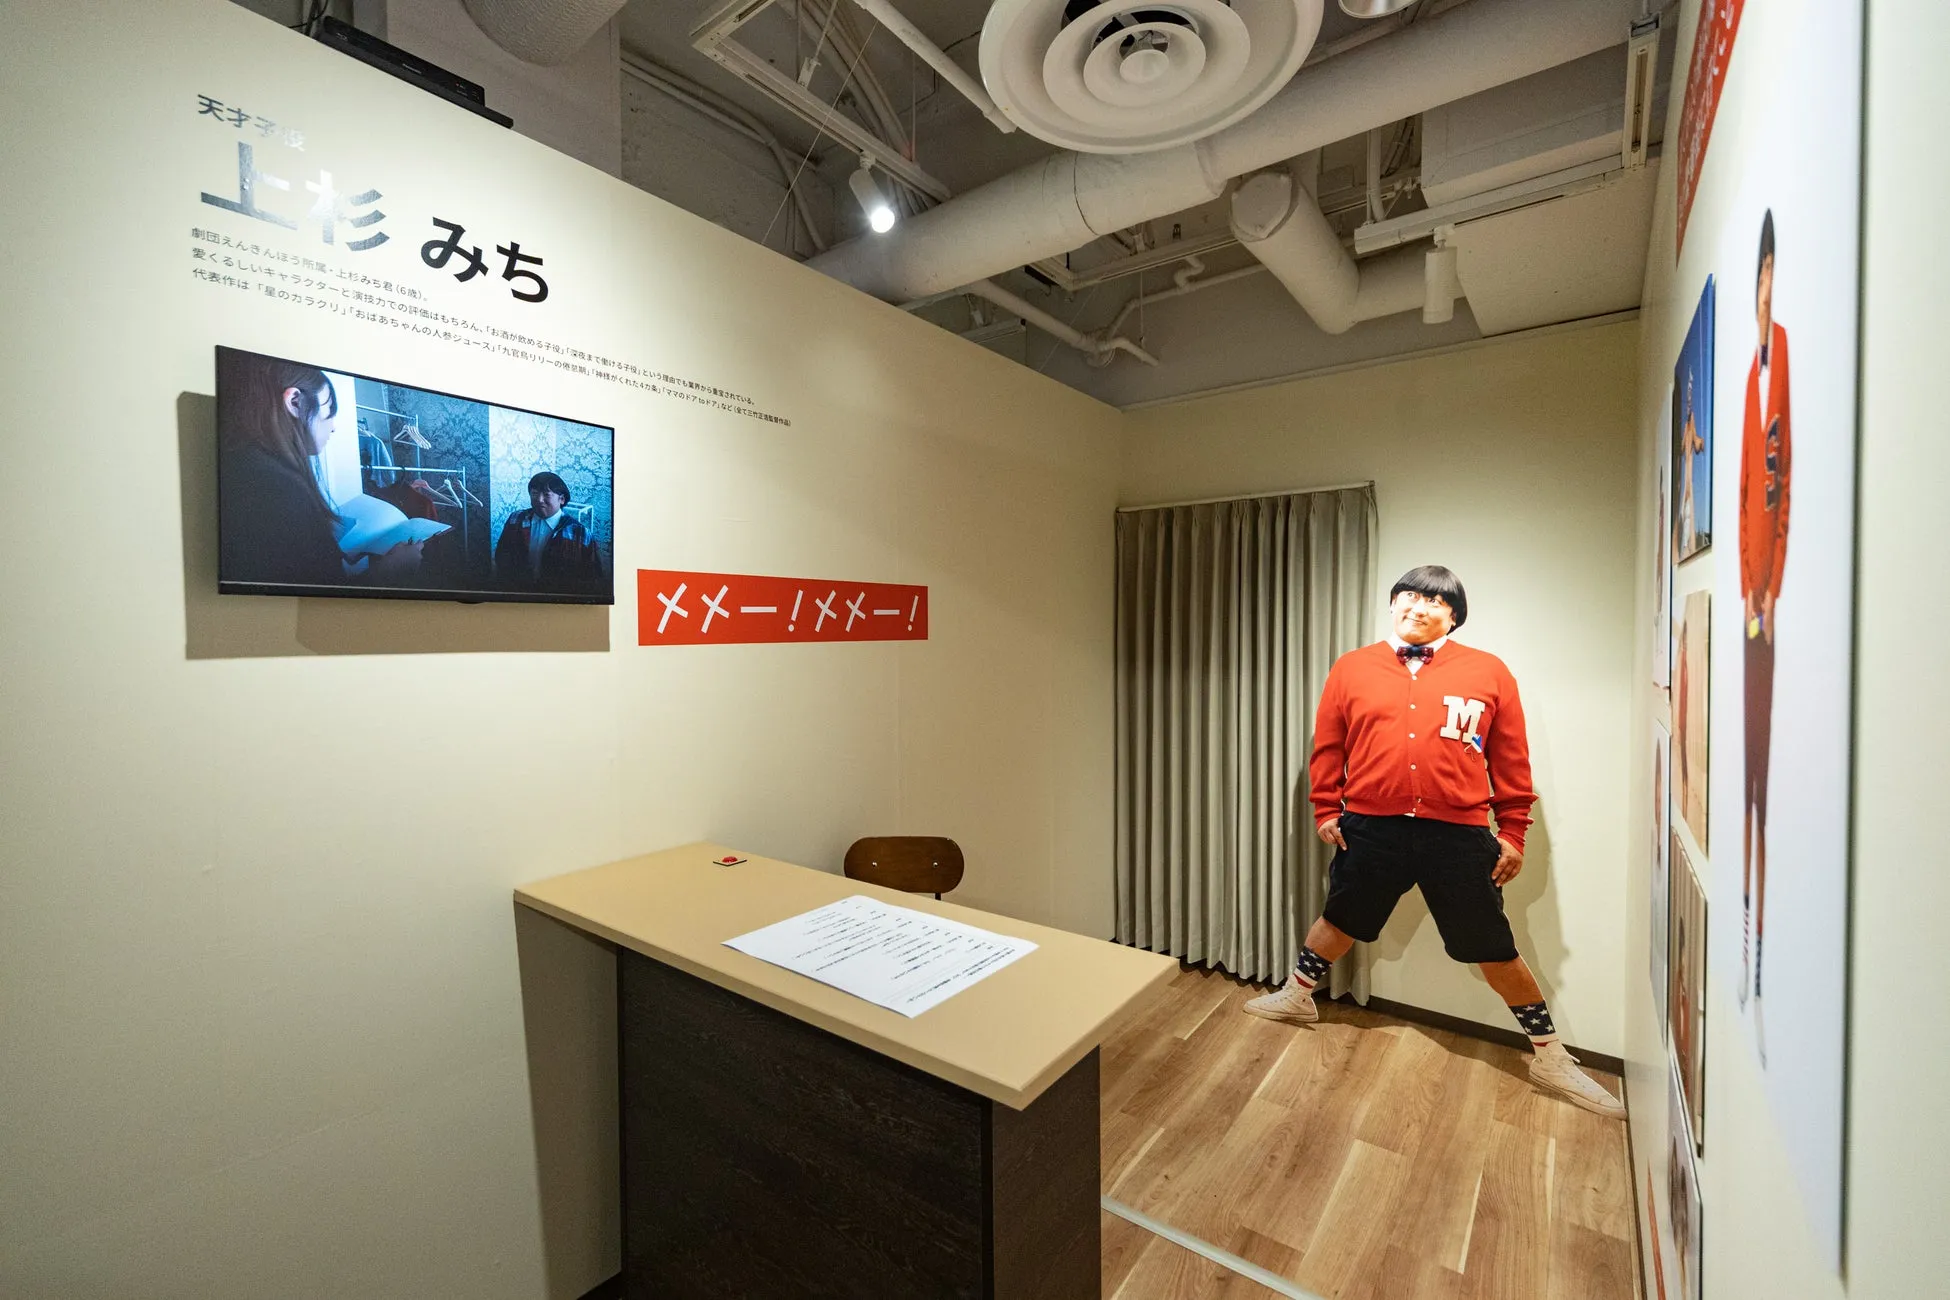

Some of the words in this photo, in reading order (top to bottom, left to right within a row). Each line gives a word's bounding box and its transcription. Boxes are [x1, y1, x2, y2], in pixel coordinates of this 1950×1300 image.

[197, 93, 306, 152] 天才子役
[200, 141, 391, 252] 上杉
[420, 216, 549, 303] みち
[1440, 695, 1486, 744] M
